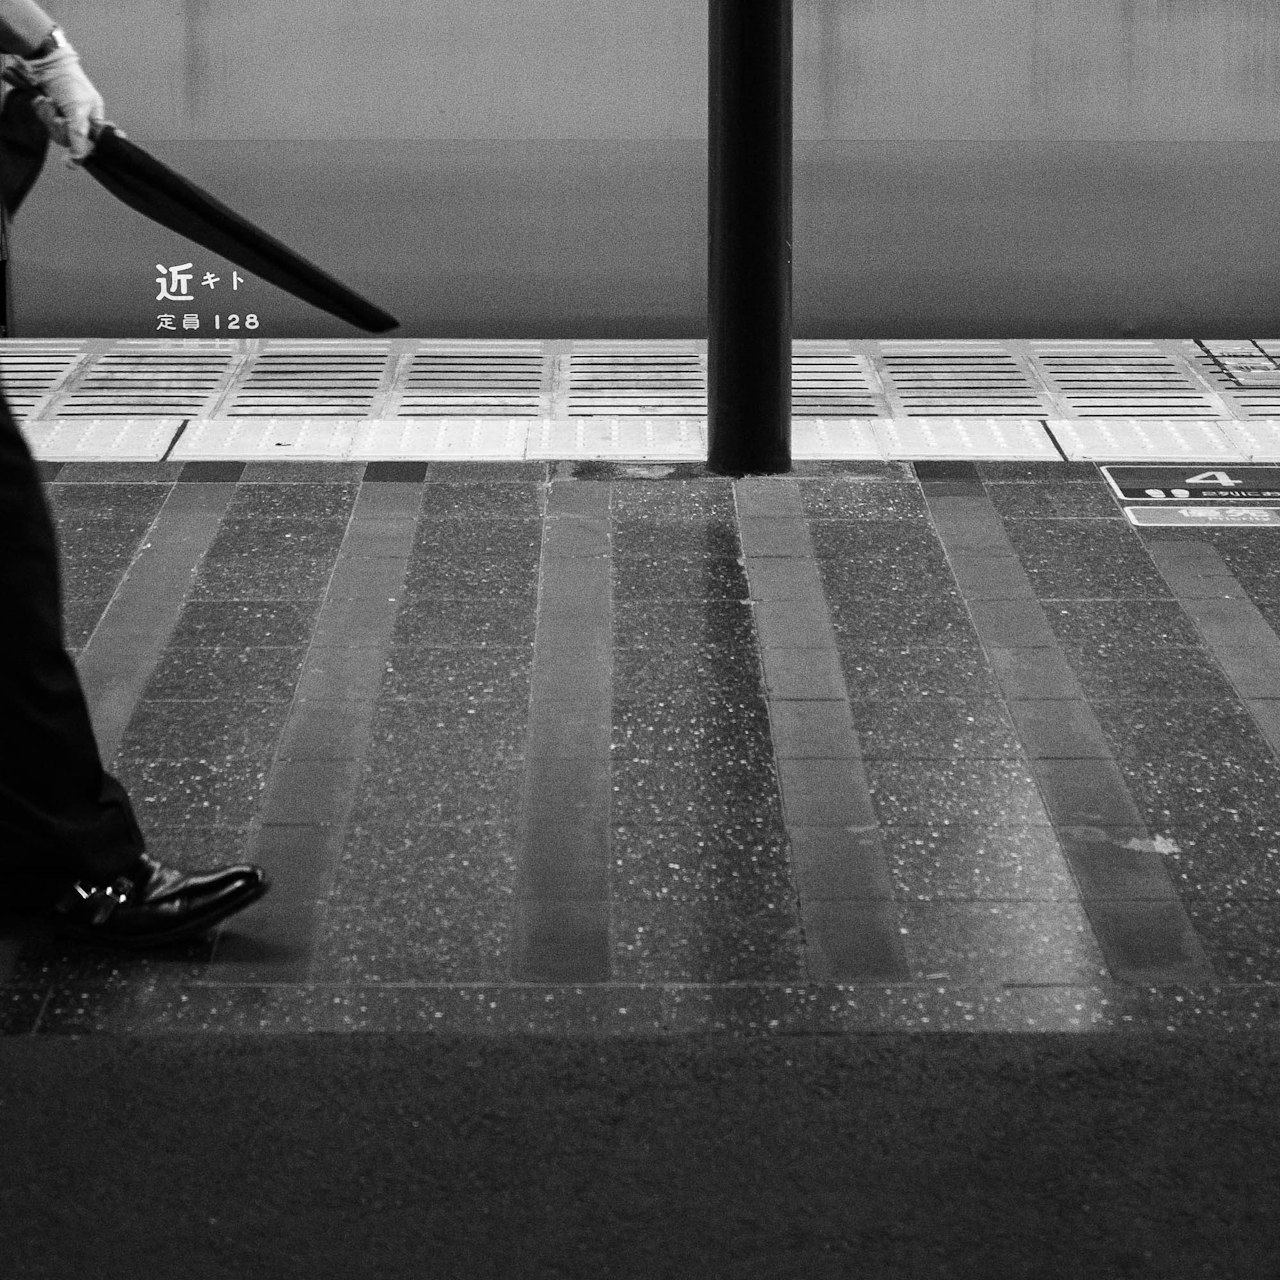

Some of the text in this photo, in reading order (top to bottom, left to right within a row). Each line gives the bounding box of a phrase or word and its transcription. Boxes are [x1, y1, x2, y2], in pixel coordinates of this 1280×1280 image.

[155, 262, 245, 301] 近 キト
[155, 313, 260, 331] 定員 128
[1184, 470, 1243, 487] 4
